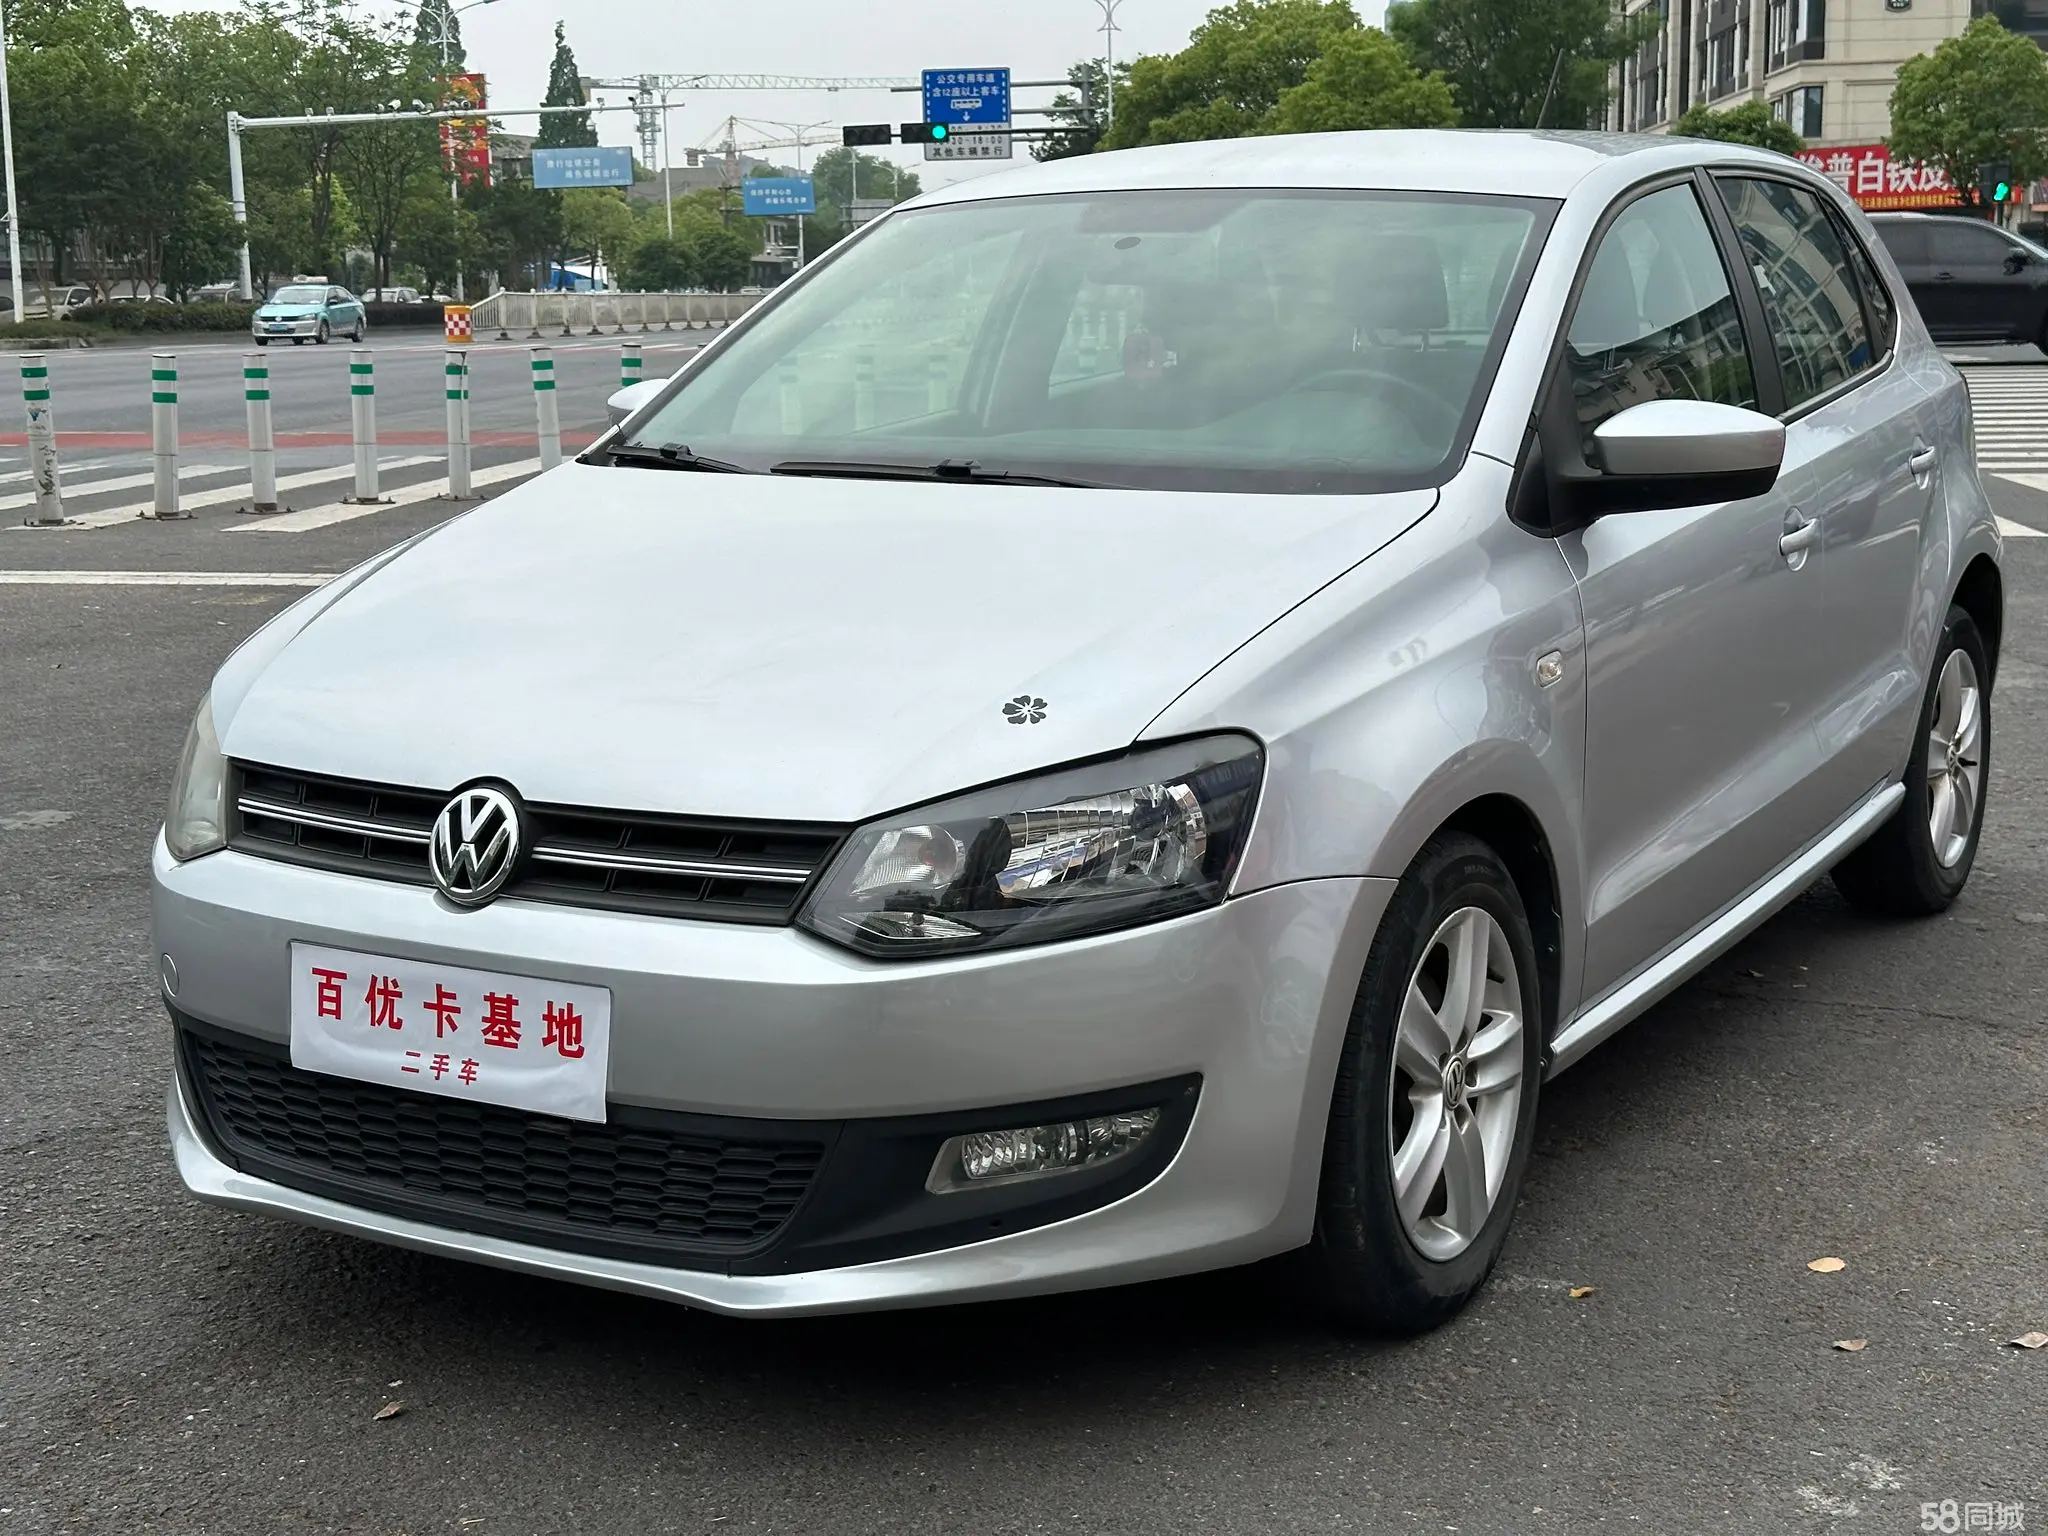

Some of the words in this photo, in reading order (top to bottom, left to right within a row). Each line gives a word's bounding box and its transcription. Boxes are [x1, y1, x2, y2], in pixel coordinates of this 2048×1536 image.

[937, 73, 995, 84] 公交专用车道
[933, 146, 1003, 157] 其他车辆禁行
[311, 967, 585, 1059] 百优卡基地
[401, 1051, 480, 1086] 二手车
